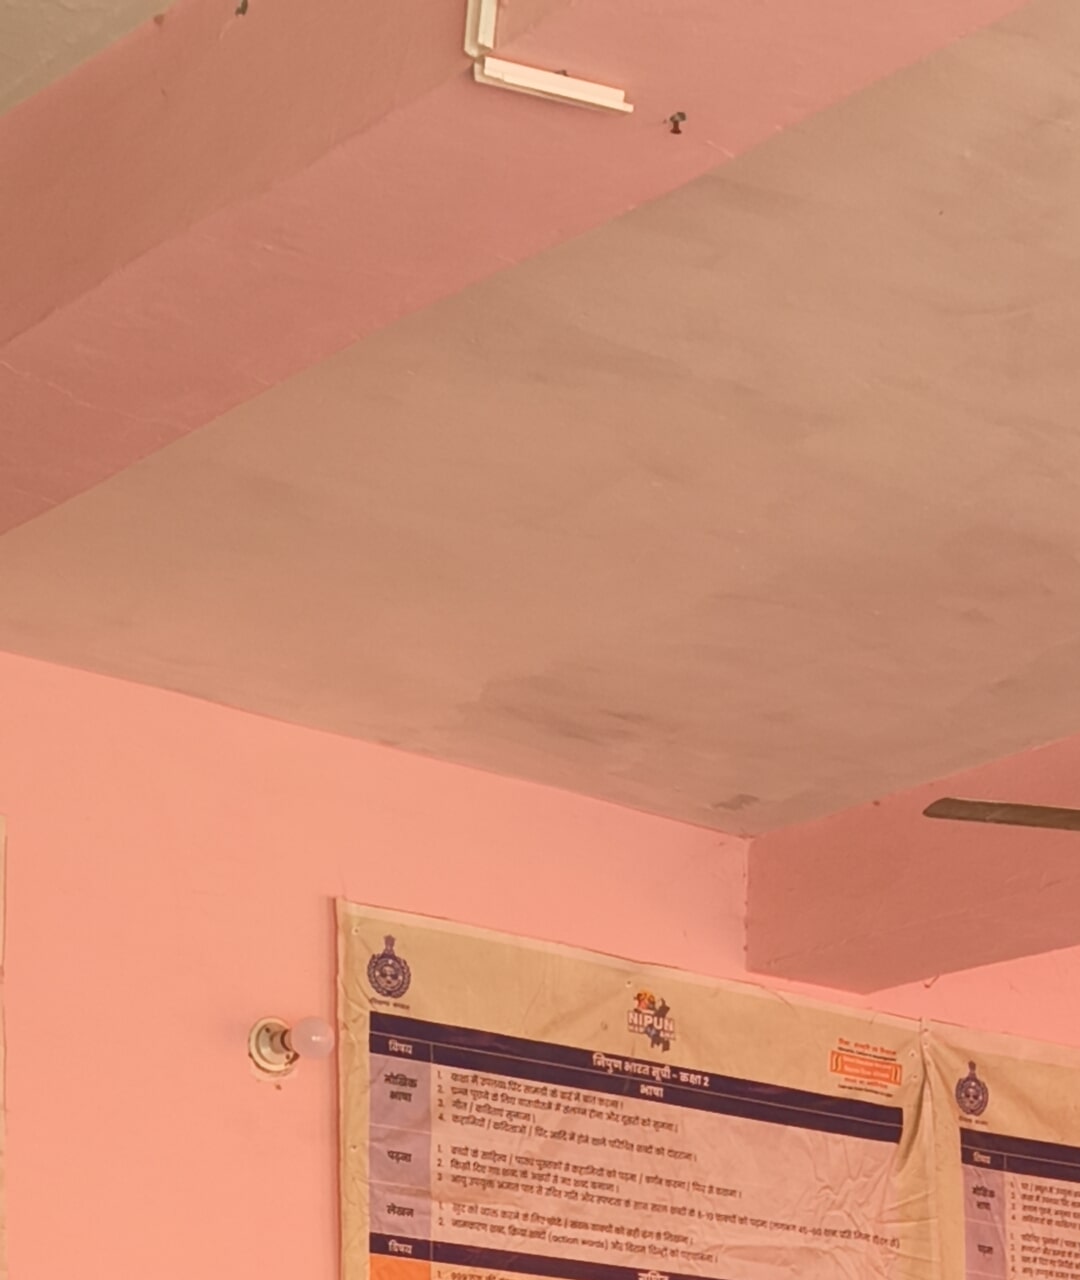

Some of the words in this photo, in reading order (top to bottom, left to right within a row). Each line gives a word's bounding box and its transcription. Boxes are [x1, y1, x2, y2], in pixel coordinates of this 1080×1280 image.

[627, 1011, 675, 1030] NIPUN
[593, 1052, 622, 1074] निपुण
[624, 1060, 650, 1076] भारत
[680, 1071, 701, 1087] कक्षा
[703, 1077, 710, 1087] 2
[641, 1084, 663, 1098] भाषा
